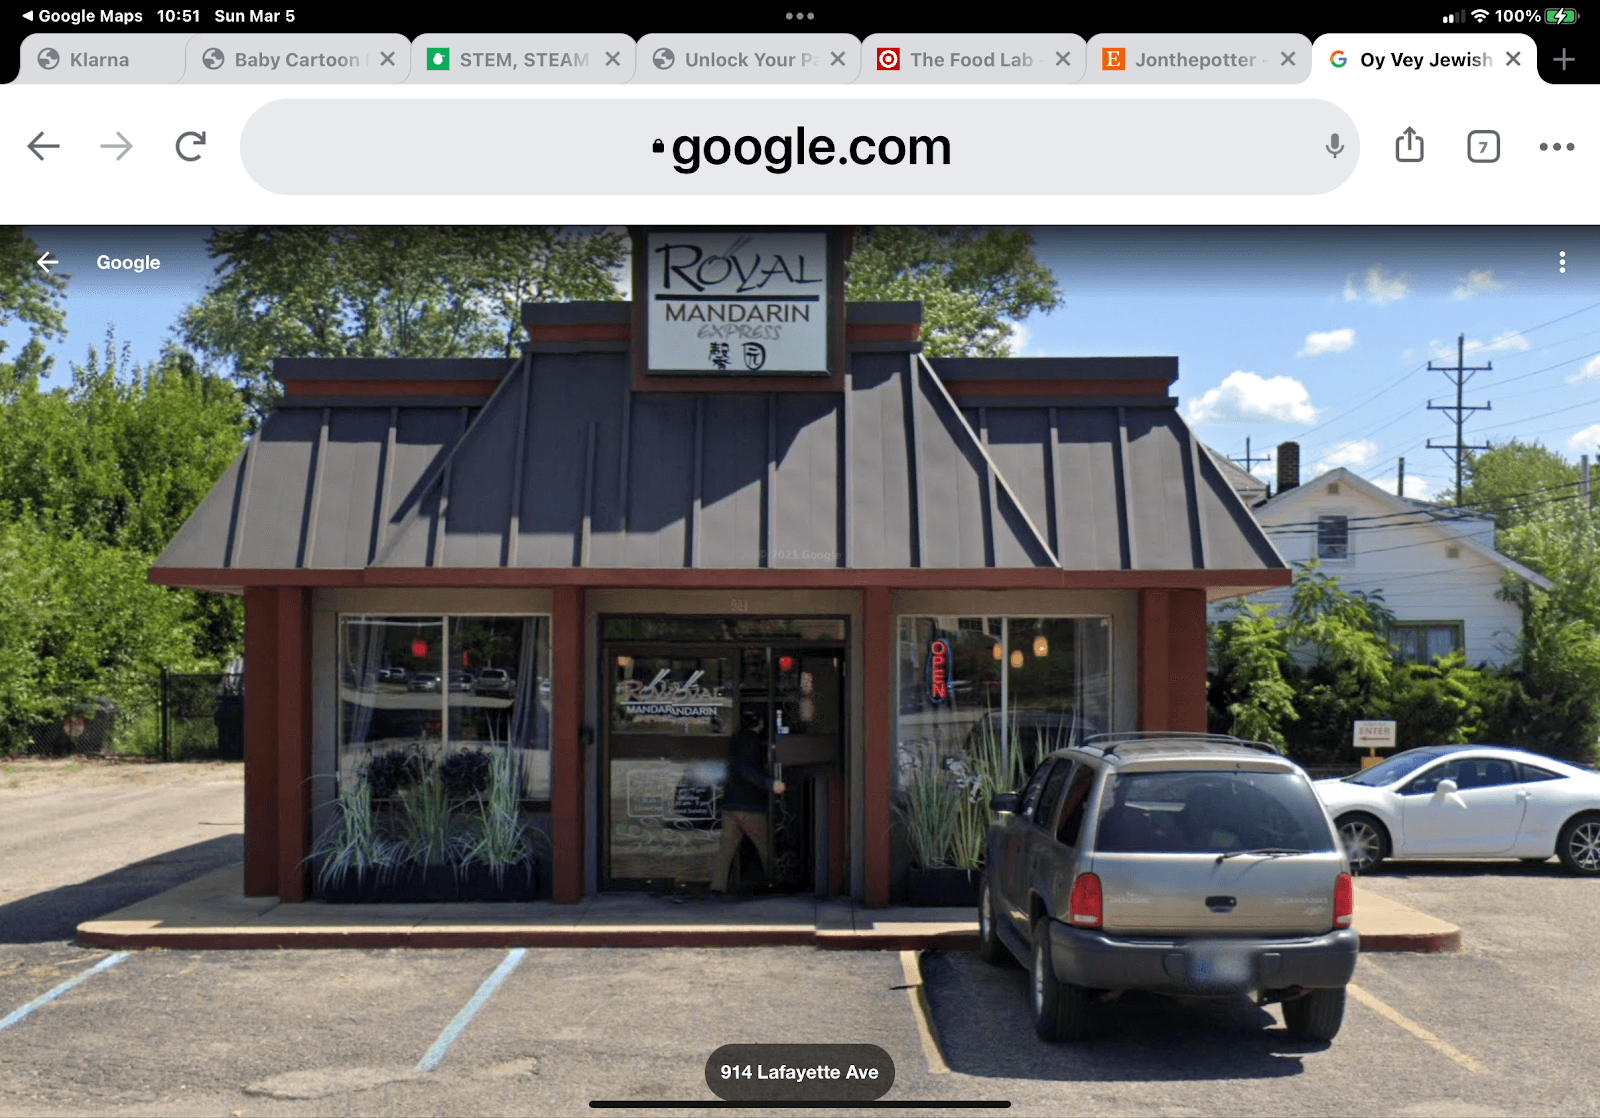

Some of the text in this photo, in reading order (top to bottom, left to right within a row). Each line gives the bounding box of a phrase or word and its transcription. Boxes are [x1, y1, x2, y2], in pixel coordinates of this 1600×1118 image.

[39, 9, 143, 25] Google Maps
[157, 10, 199, 22] 10:51
[215, 10, 295, 22] Sun Mar 5
[1495, 10, 1541, 23] 100%
[70, 52, 129, 67] Klarna
[235, 52, 280, 71] Baby
[286, 52, 360, 67] Cartoon
[460, 52, 589, 70] STEM, STEAM
[686, 52, 749, 67] Unlock
[754, 52, 796, 67] Your
[910, 52, 944, 67] The
[951, 52, 995, 67] Food
[1001, 52, 1034, 67] Lab
[1135, 52, 1257, 70] Jonthepotter
[1361, 51, 1493, 70] Oy Vey Jewish
[672, 126, 951, 174] google.com
[1478, 141, 1489, 154] 7
[654, 242, 823, 293] ROYAL
[665, 303, 810, 323] MANDARIN
[931, 640, 948, 699] OPEN
[1359, 727, 1391, 736] ENTER
